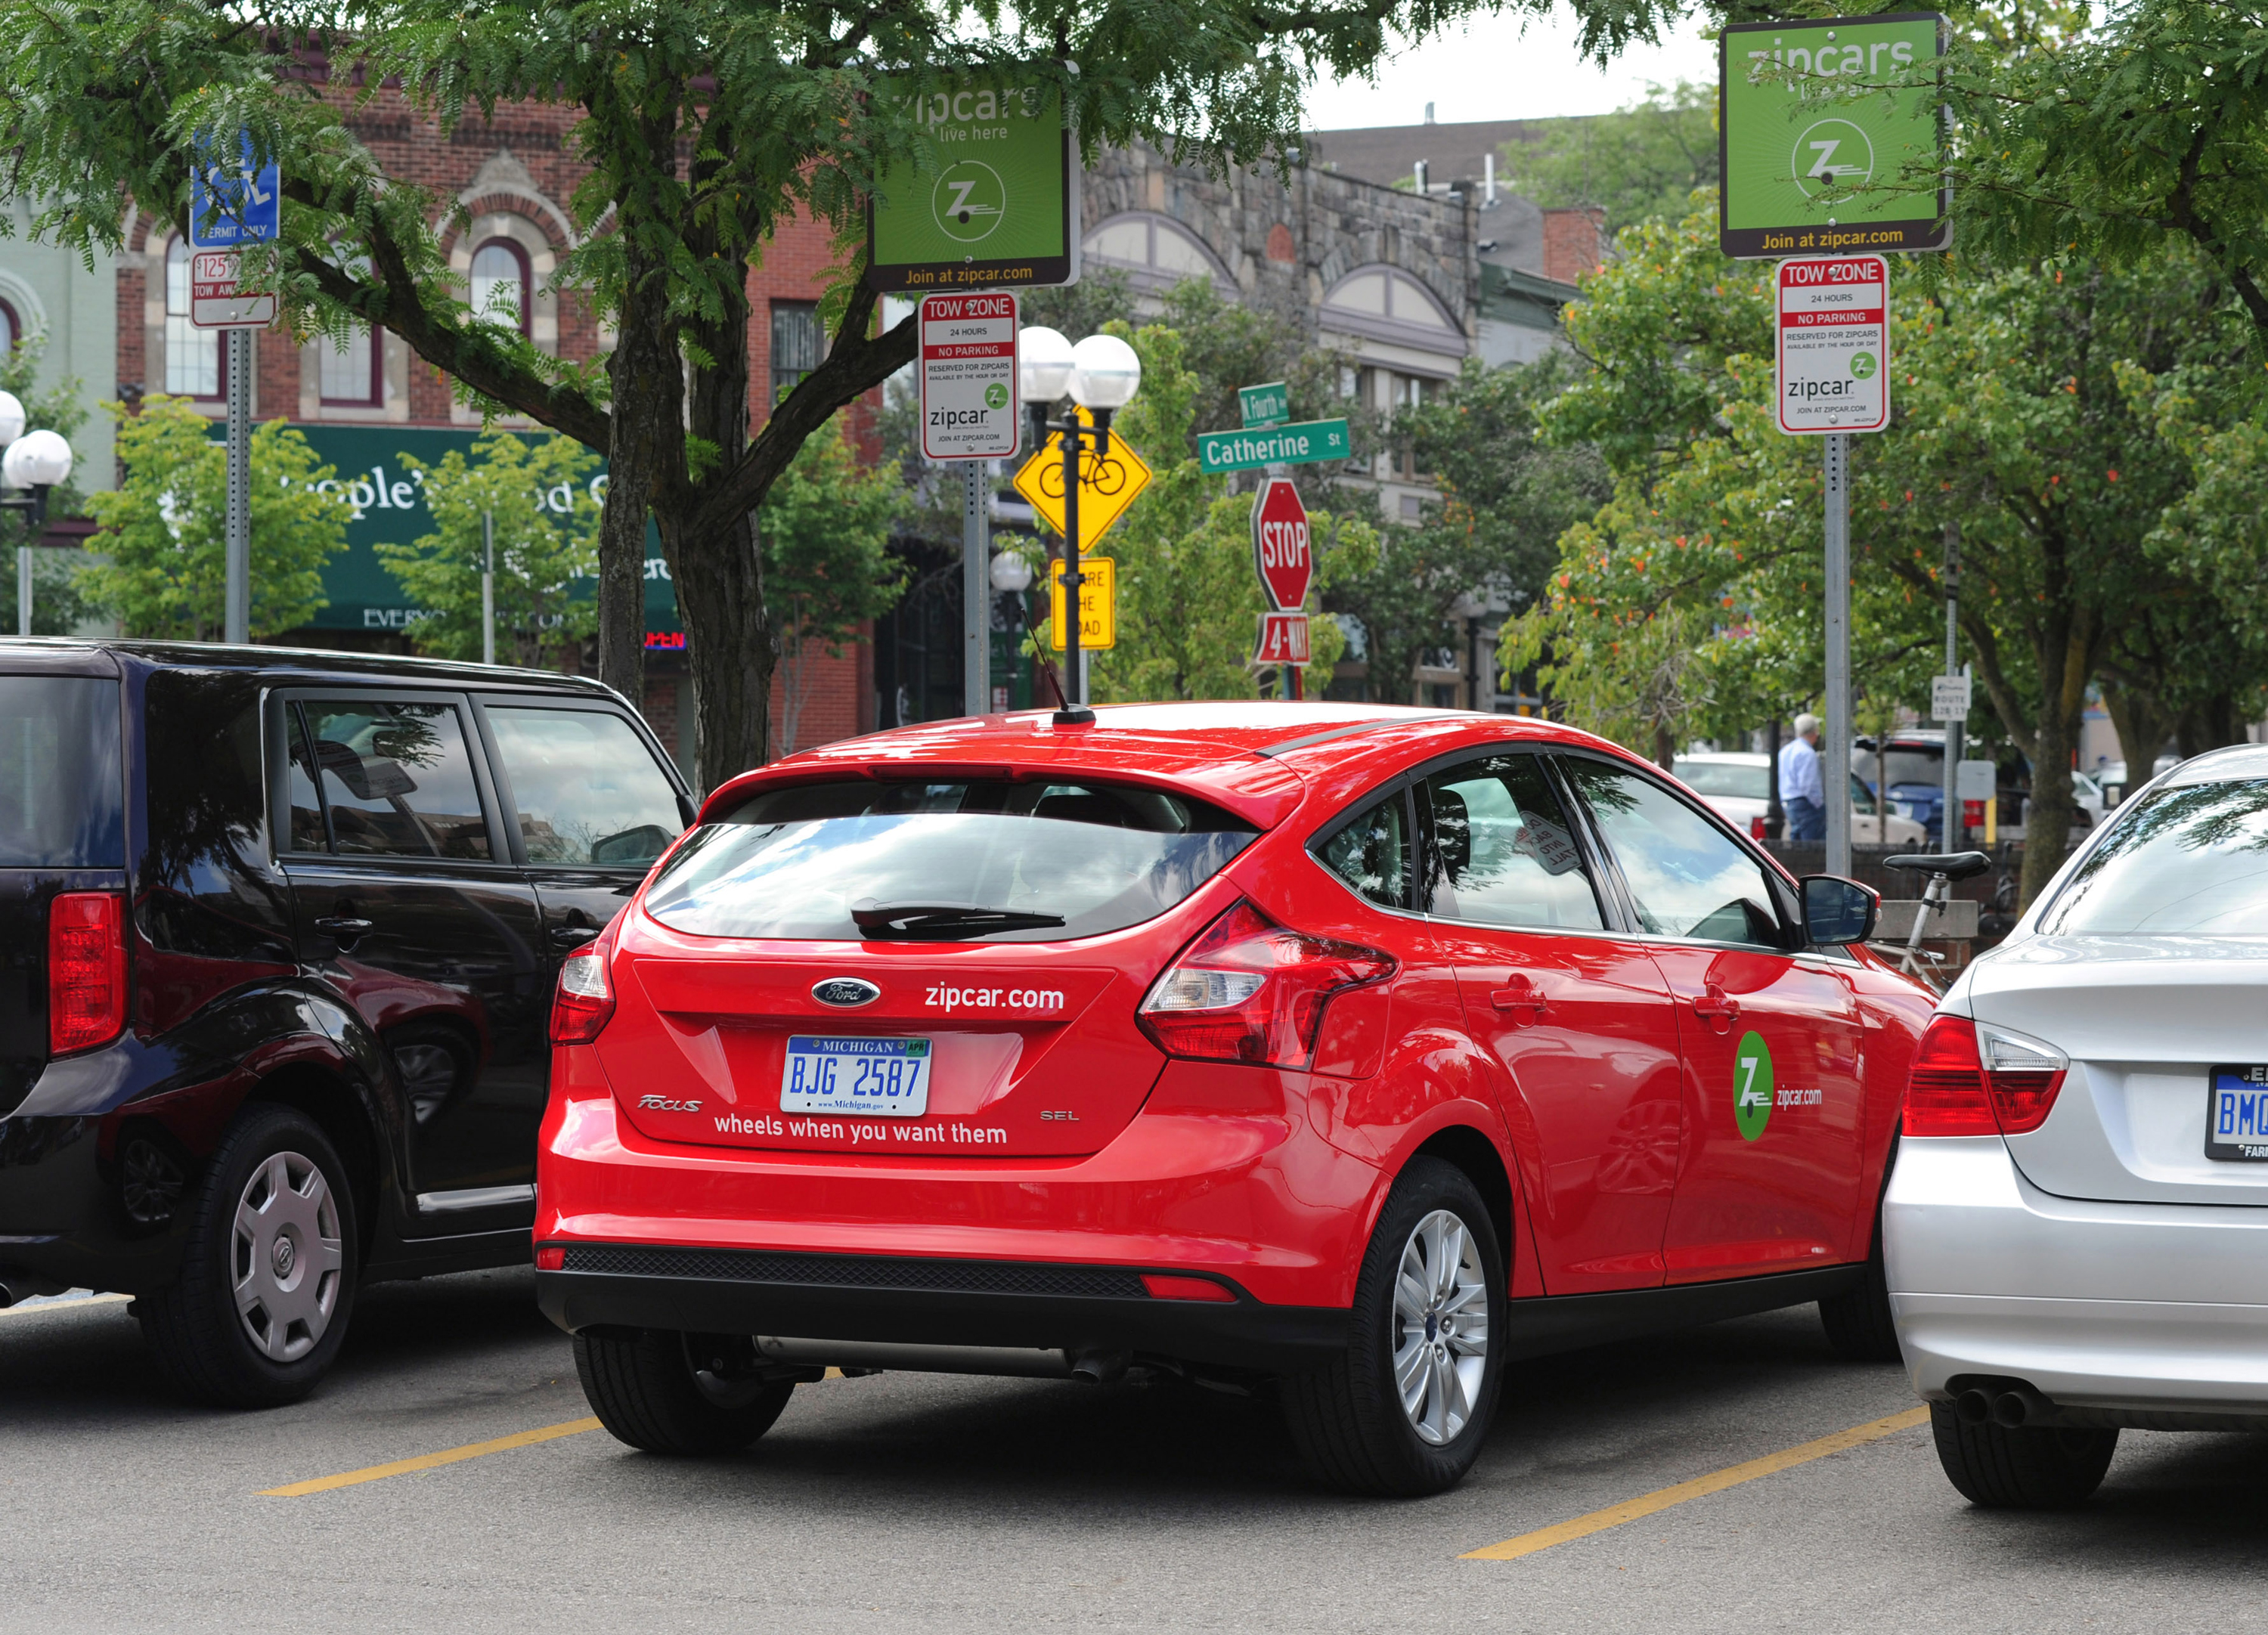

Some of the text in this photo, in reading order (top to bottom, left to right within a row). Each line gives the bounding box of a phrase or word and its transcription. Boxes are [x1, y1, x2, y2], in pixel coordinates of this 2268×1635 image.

[940, 125, 1008, 142] live here
[1762, 231, 1903, 249] Join at zipcar.com
[906, 267, 1033, 285] Join at zipcar.com
[1786, 262, 1879, 283] TOW ZONE
[194, 285, 214, 297] TOW
[1811, 294, 1852, 303] 24 HOURS
[928, 298, 1010, 317] TOW ZONE
[1798, 312, 1866, 324] NO PARKING
[950, 327, 987, 336] 24 HOURS
[1786, 333, 1826, 341] RESERVED
[1845, 330, 1878, 339] ZIPCARS
[938, 345, 999, 357] NO PARKING
[928, 364, 963, 373] RESERVED
[1788, 376, 1854, 401] zipcar
[1824, 405, 1867, 413] ZIPCAR.COM
[931, 407, 988, 429] zipcar
[1207, 432, 1340, 465] Catherine St
[1263, 521, 1307, 568] STOP
[1080, 596, 1095, 611] HE
[826, 981, 1064, 1012] Ford zipcar.com
[823, 1041, 894, 1053] MICHIGAN
[790, 1057, 921, 1097] BJG 2587
[818, 1100, 884, 1110] www.Michigan.gov
[1777, 1084, 1822, 1111] zipcar.com
[1040, 1110, 1080, 1121] SEL
[714, 1115, 1007, 1144] wheels when you want them
